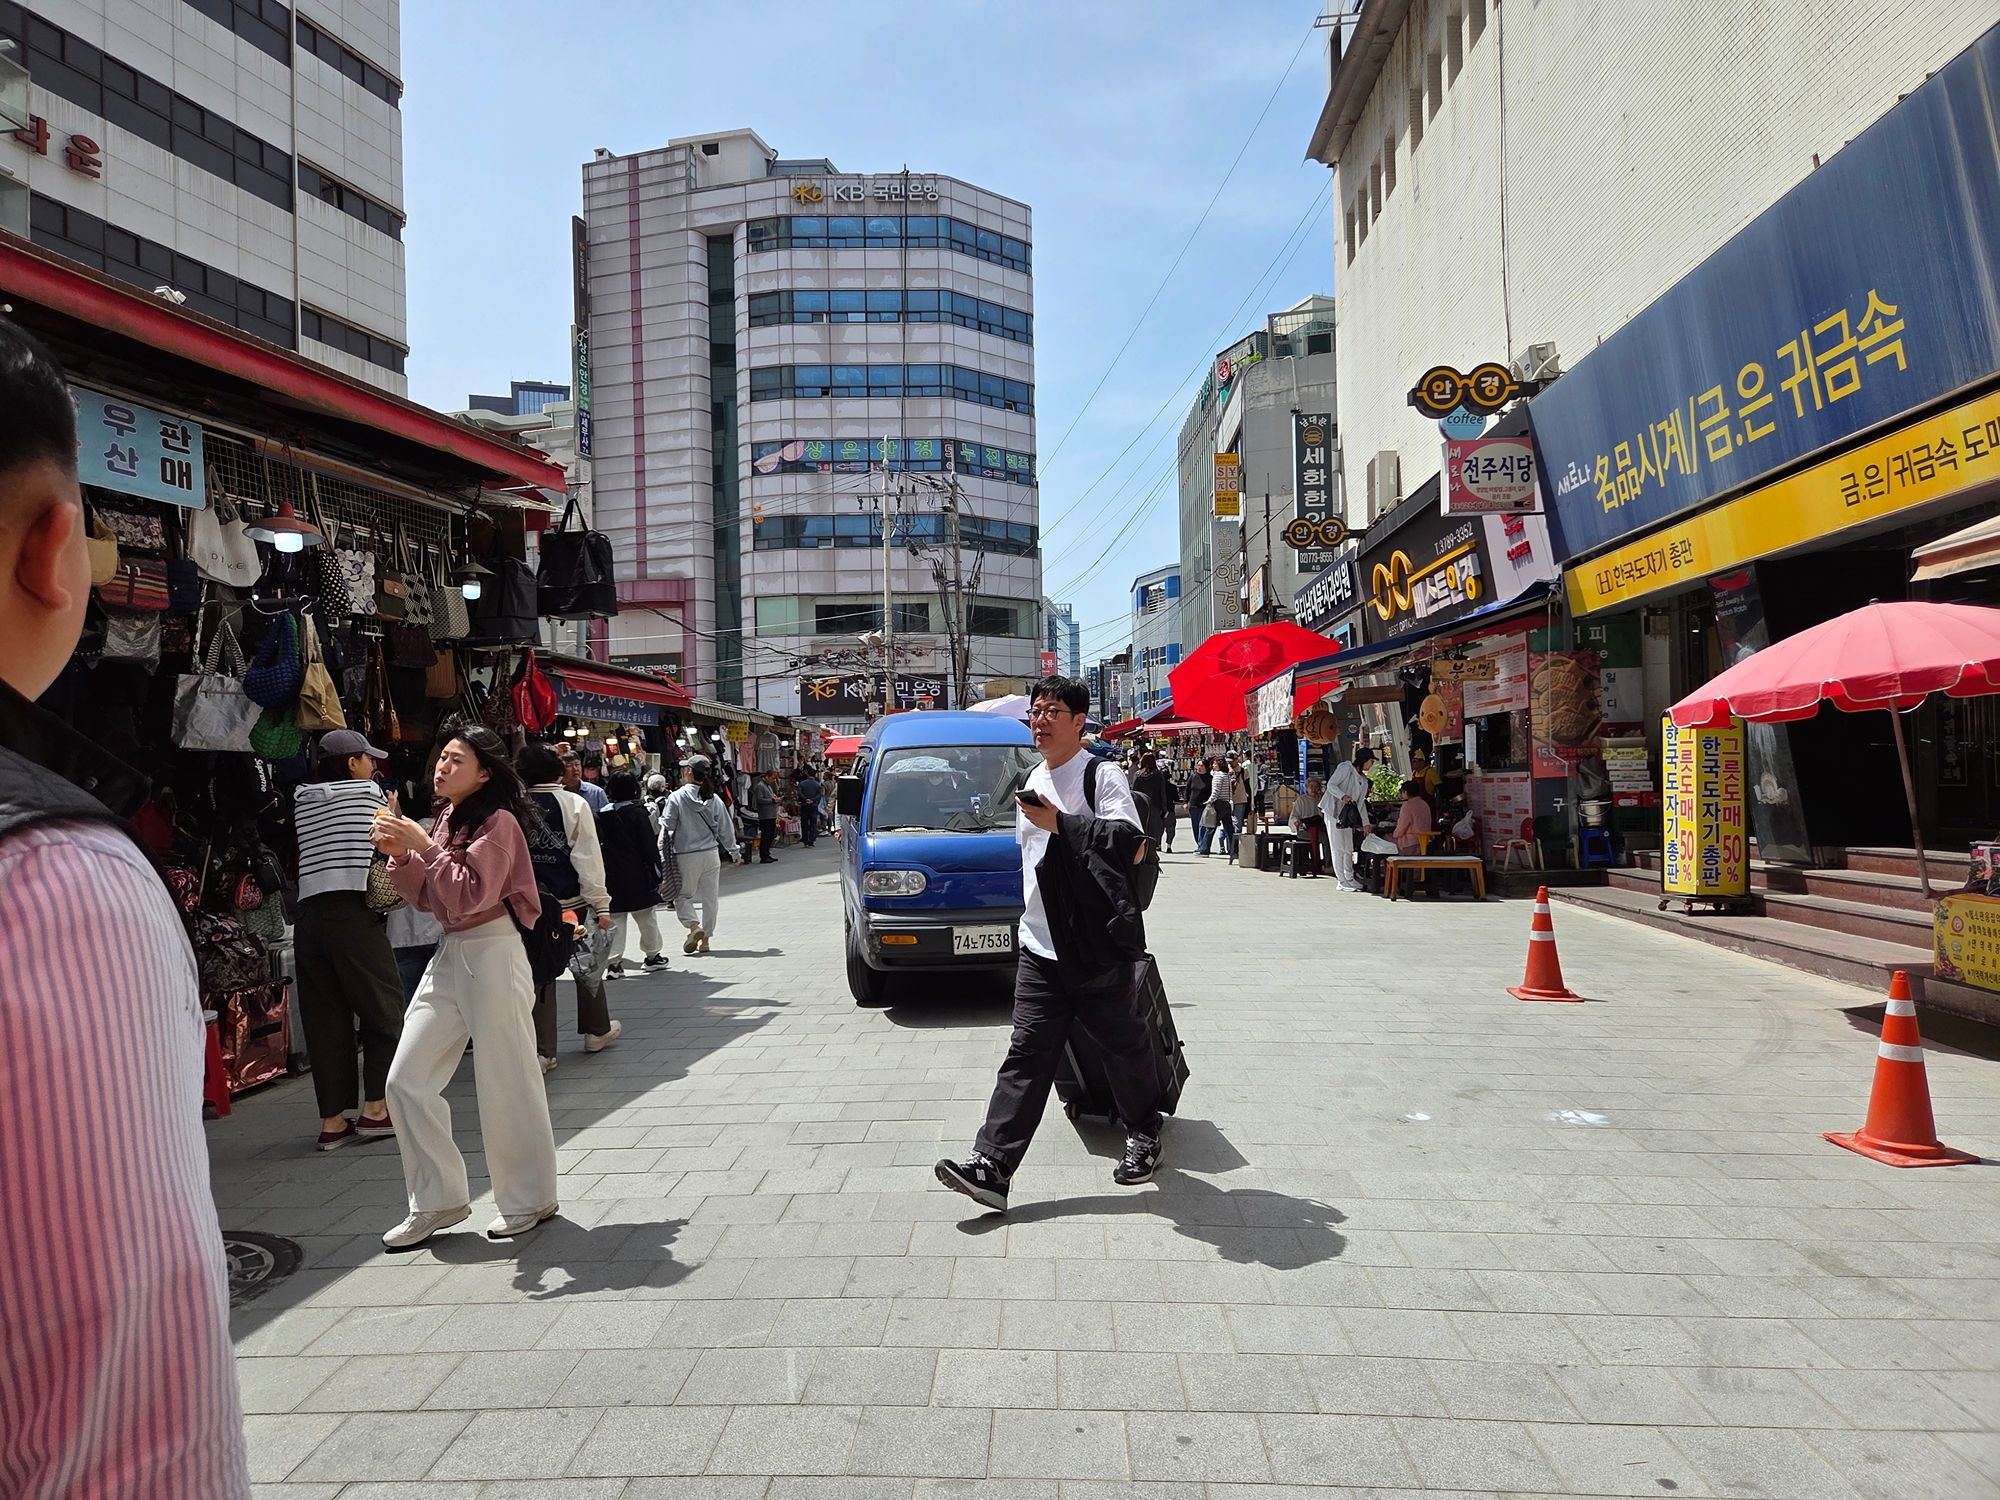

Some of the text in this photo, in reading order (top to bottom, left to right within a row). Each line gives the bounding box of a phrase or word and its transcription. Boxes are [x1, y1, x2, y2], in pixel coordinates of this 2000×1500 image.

[833, 183, 939, 202] KB 국민은행
[1299, 416, 1328, 427] 남대문
[1446, 412, 1484, 425] coffee
[102, 402, 193, 492] 우산 판매
[1463, 455, 1533, 484] 전주식당
[1557, 461, 1591, 496] 새로나
[1613, 548, 1668, 587] 한국도자기
[1669, 537, 1694, 569] 총판
[1448, 662, 1491, 680] 붕어빵
[1722, 738, 1742, 827] 그릇도매
[955, 933, 1010, 950] 74노7538
